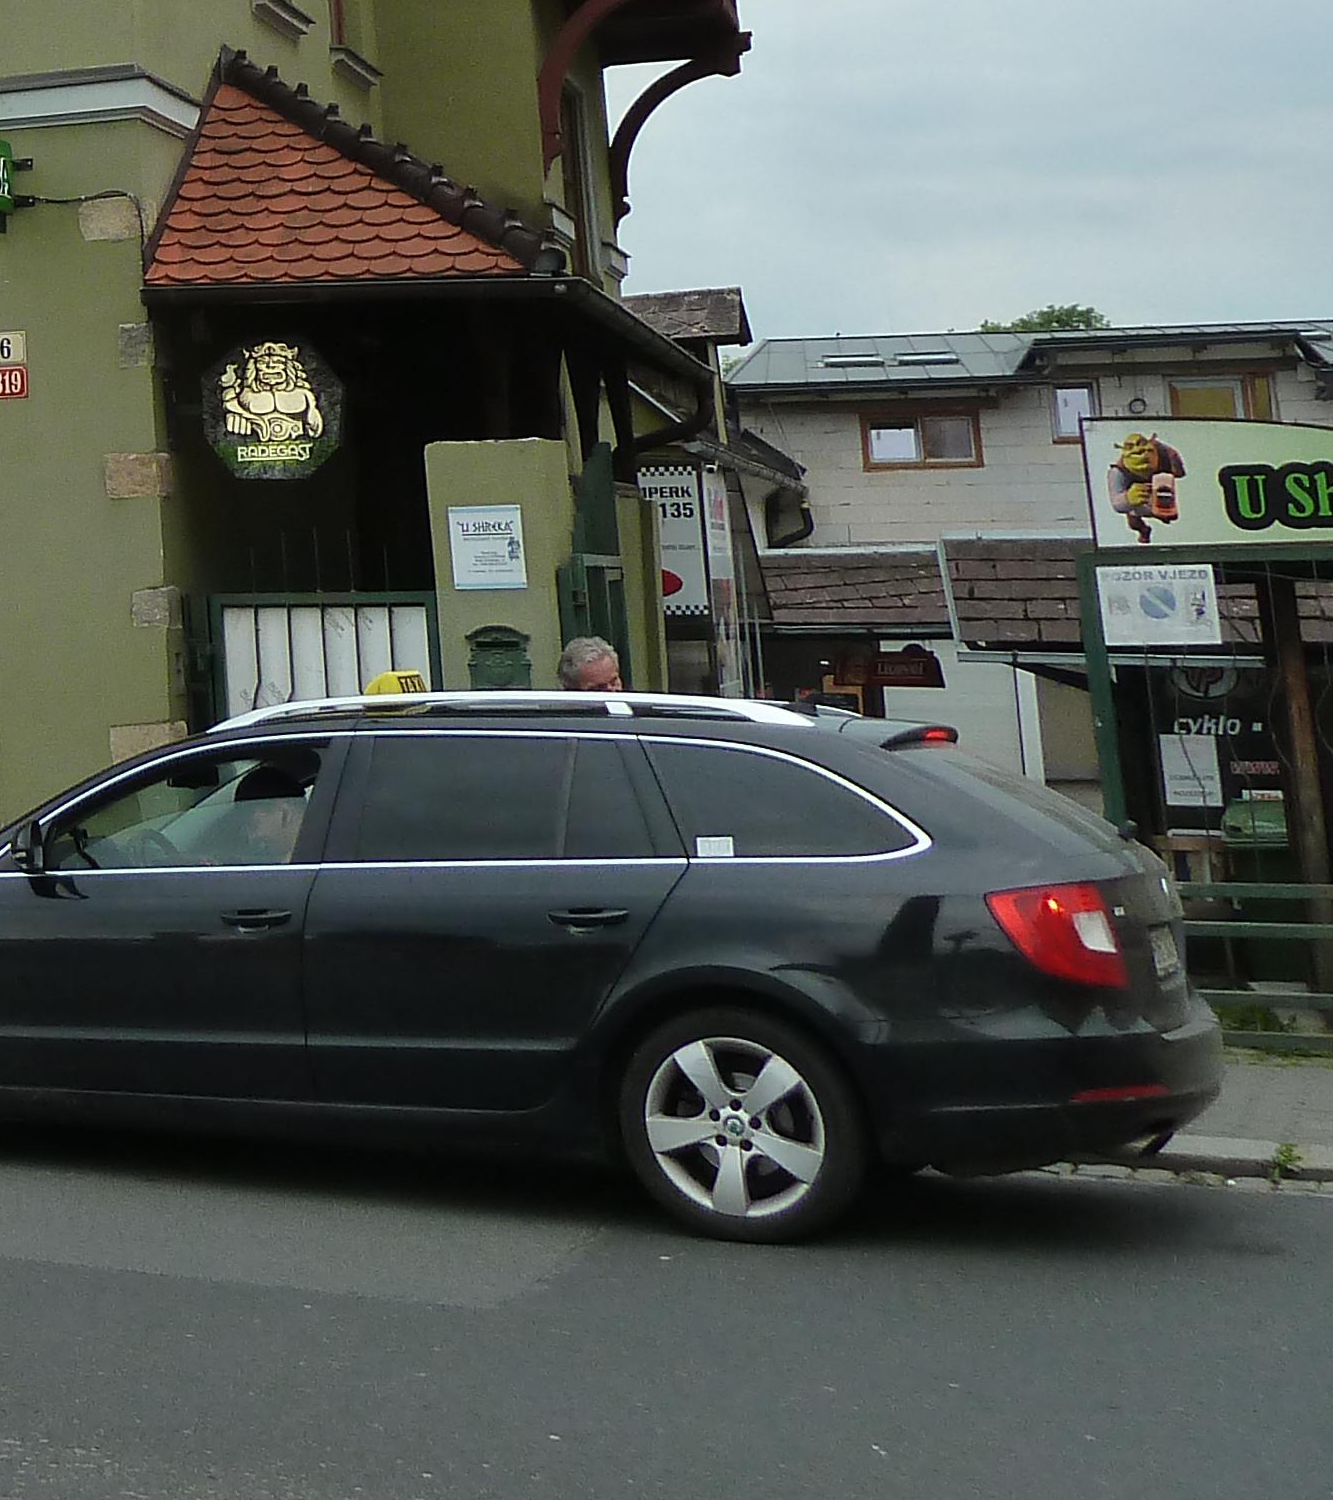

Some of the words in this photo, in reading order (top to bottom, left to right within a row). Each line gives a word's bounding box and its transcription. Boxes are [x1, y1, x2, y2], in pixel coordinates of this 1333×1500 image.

[0, 337, 12, 360] 6
[237, 443, 314, 462] RADEGAST
[1228, 470, 1271, 523] U
[1101, 570, 1153, 581] OZOR
[1157, 569, 1209, 581] VJEZD
[398, 675, 426, 693] TAXI
[1173, 713, 1241, 736] cyklo
